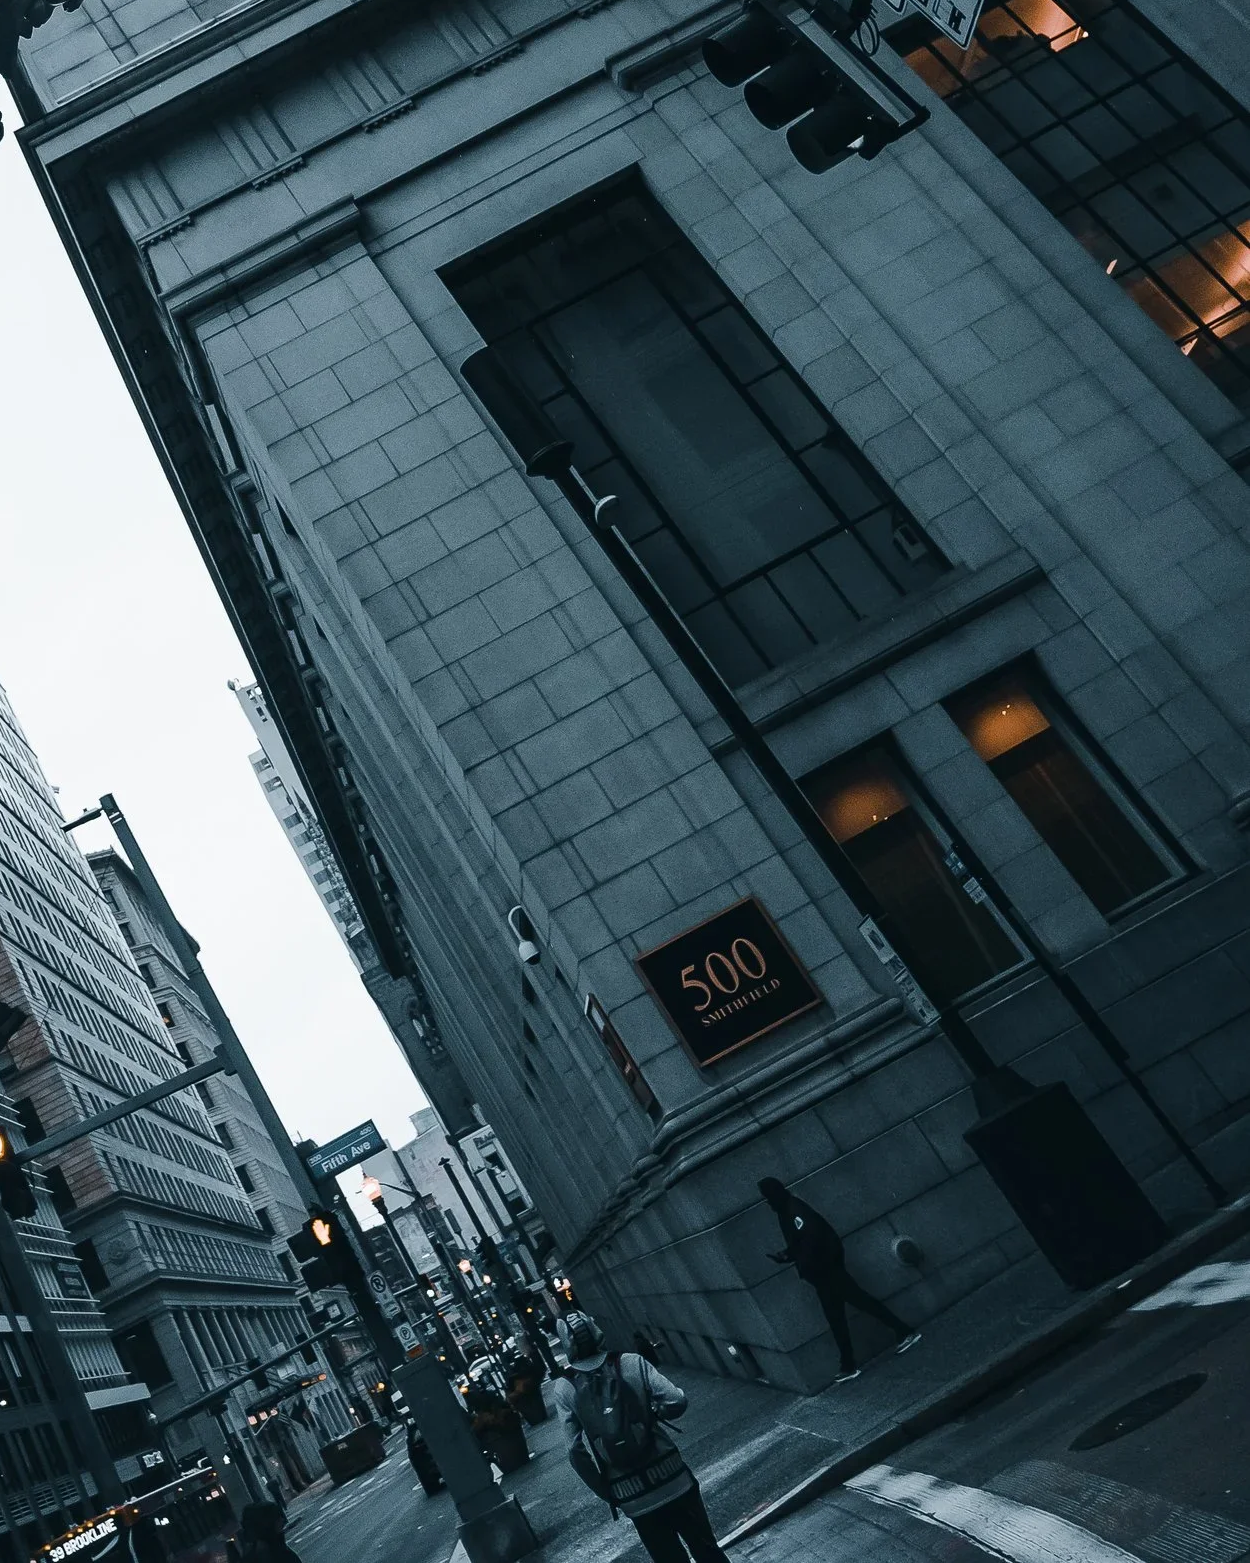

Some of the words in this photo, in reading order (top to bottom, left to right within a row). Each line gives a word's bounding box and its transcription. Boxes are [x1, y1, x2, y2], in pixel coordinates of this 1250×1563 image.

[680, 937, 767, 1012] 500
[701, 978, 781, 1028] SMITHFIELD
[321, 1153, 349, 1173] Fifth
[351, 1141, 371, 1158] Ave
[611, 1475, 646, 1499] UMA
[49, 1545, 66, 1563] 39
[62, 1517, 118, 1556] BROOKLINE
